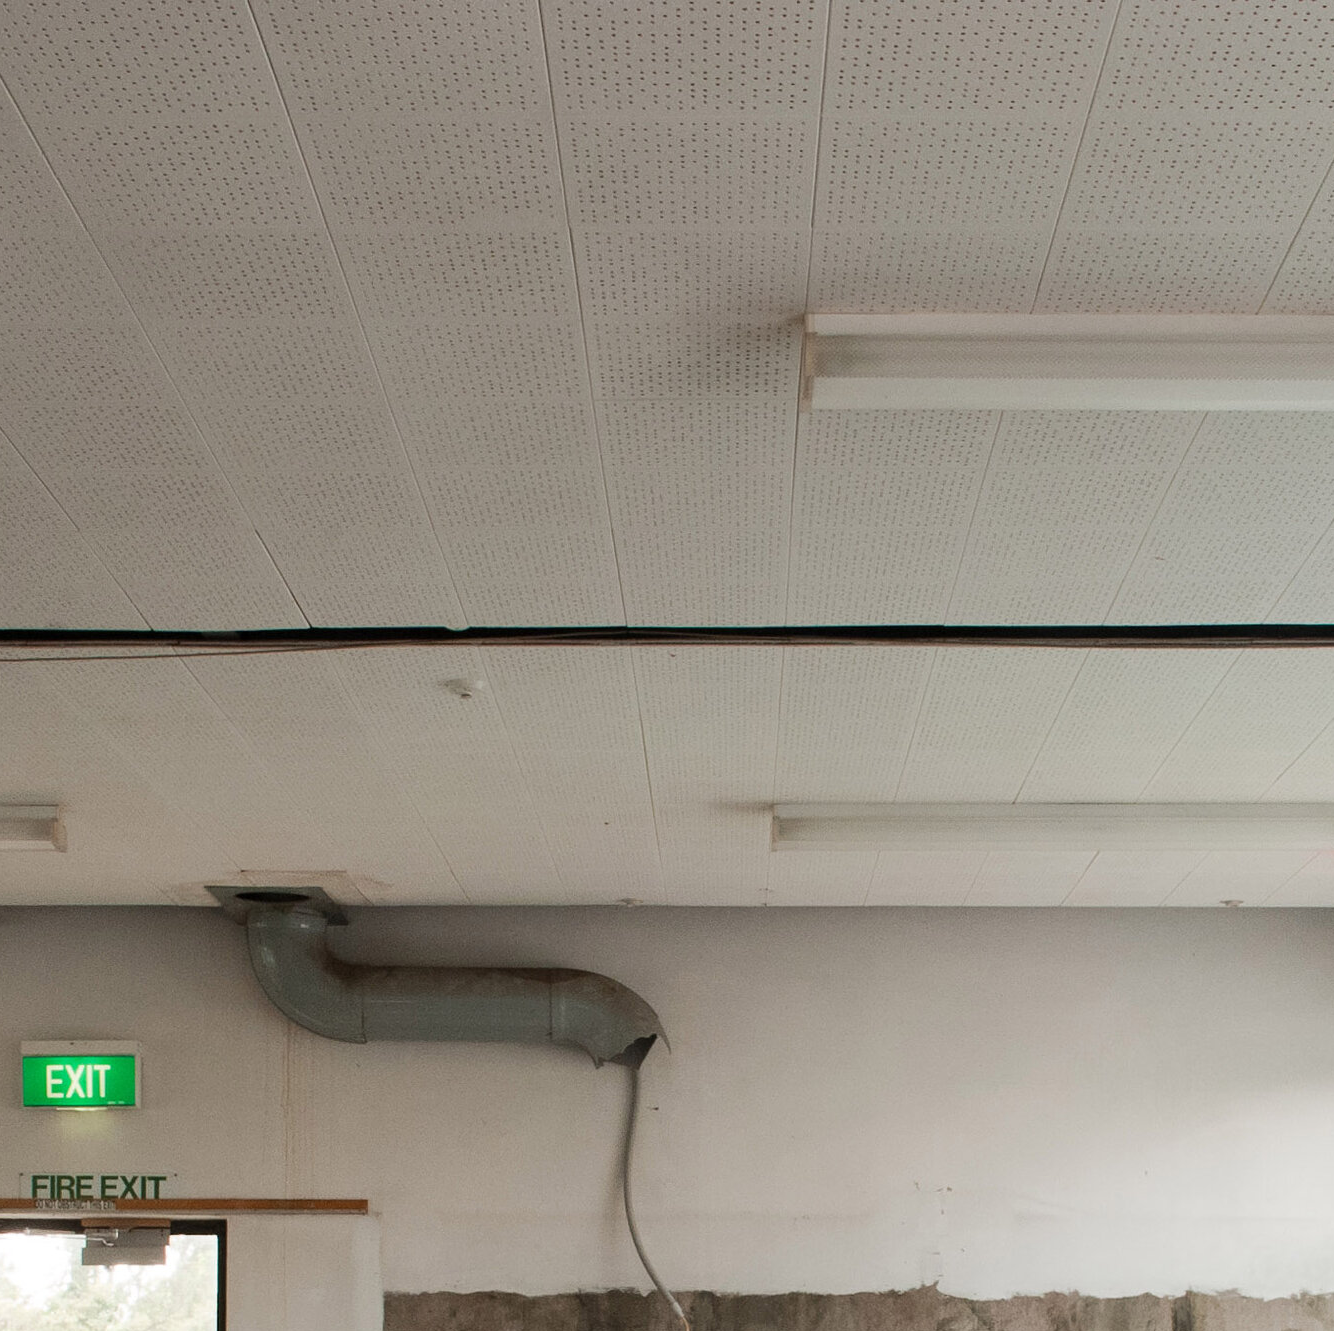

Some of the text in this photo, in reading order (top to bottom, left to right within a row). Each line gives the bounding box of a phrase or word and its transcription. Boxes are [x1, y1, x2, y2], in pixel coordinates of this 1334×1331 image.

[46, 1064, 111, 1098] EXIT
[32, 1175, 167, 1200] FIRE EXIT
